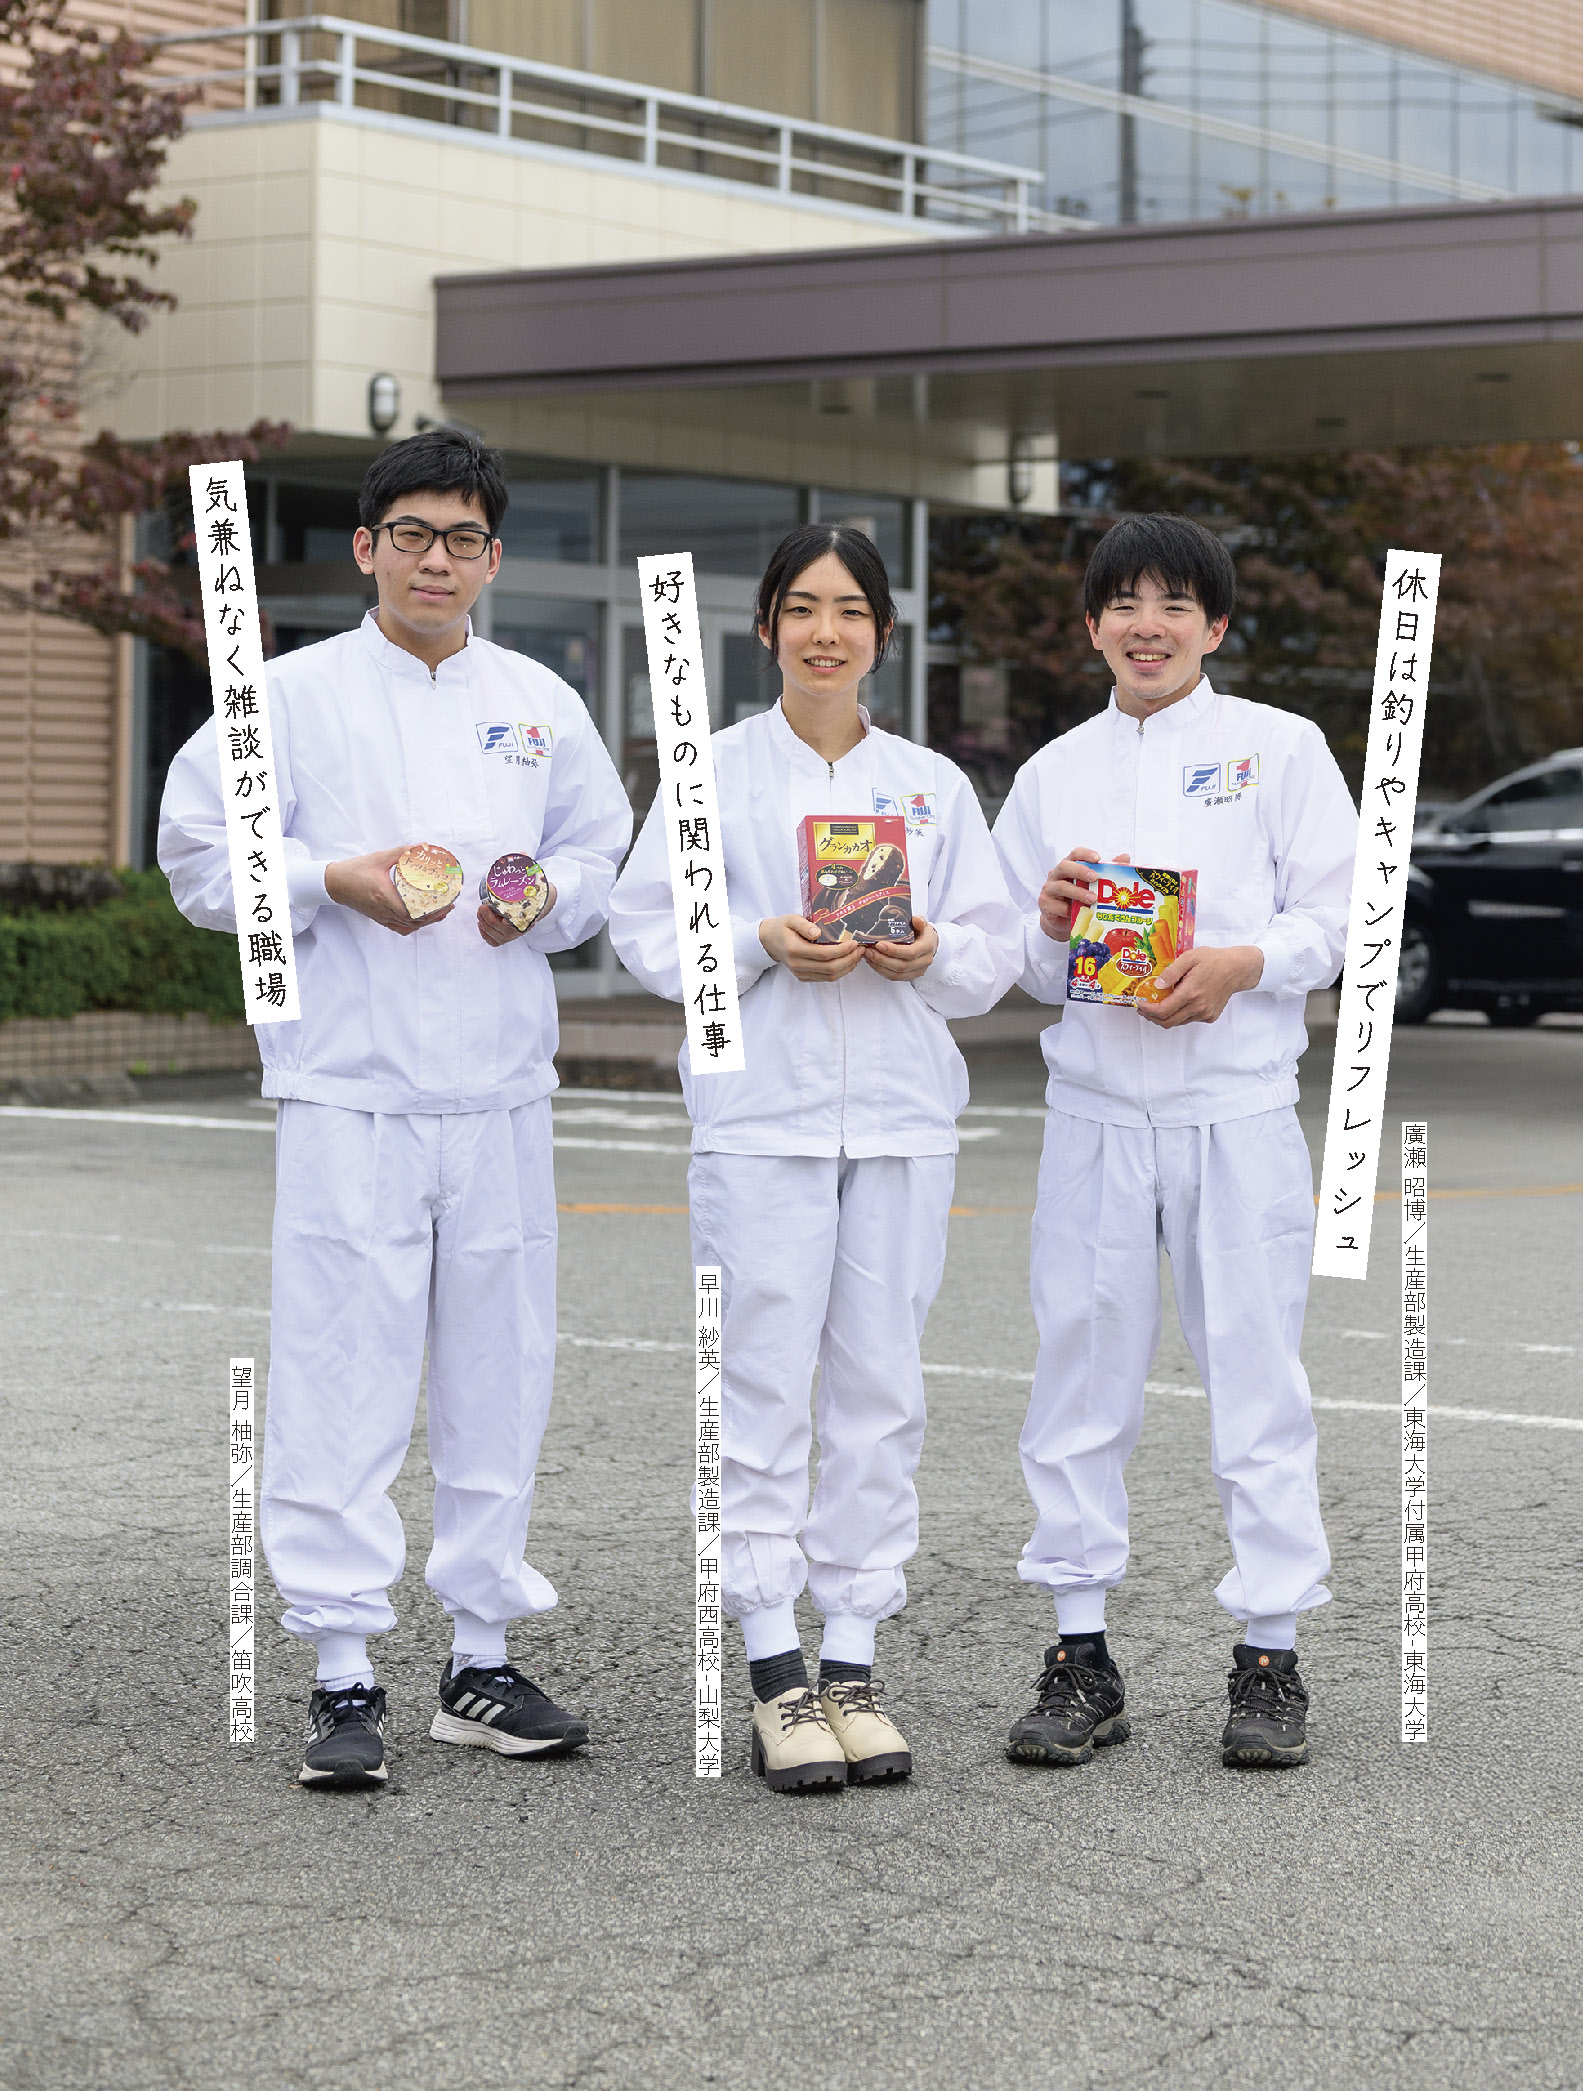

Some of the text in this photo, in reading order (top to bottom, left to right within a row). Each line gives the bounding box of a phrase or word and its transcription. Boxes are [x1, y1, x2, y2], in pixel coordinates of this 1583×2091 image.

[527, 737, 546, 747] FUJI
[911, 806, 931, 816] FUJI
[819, 837, 873, 854] グランカカオ
[415, 850, 443, 868] カリッと
[493, 864, 526, 877] じゅわっと
[490, 874, 535, 889] ラムレーズン
[1097, 879, 1156, 909] Dole
[1122, 948, 1147, 961] Dole
[1075, 956, 1096, 976] 16
